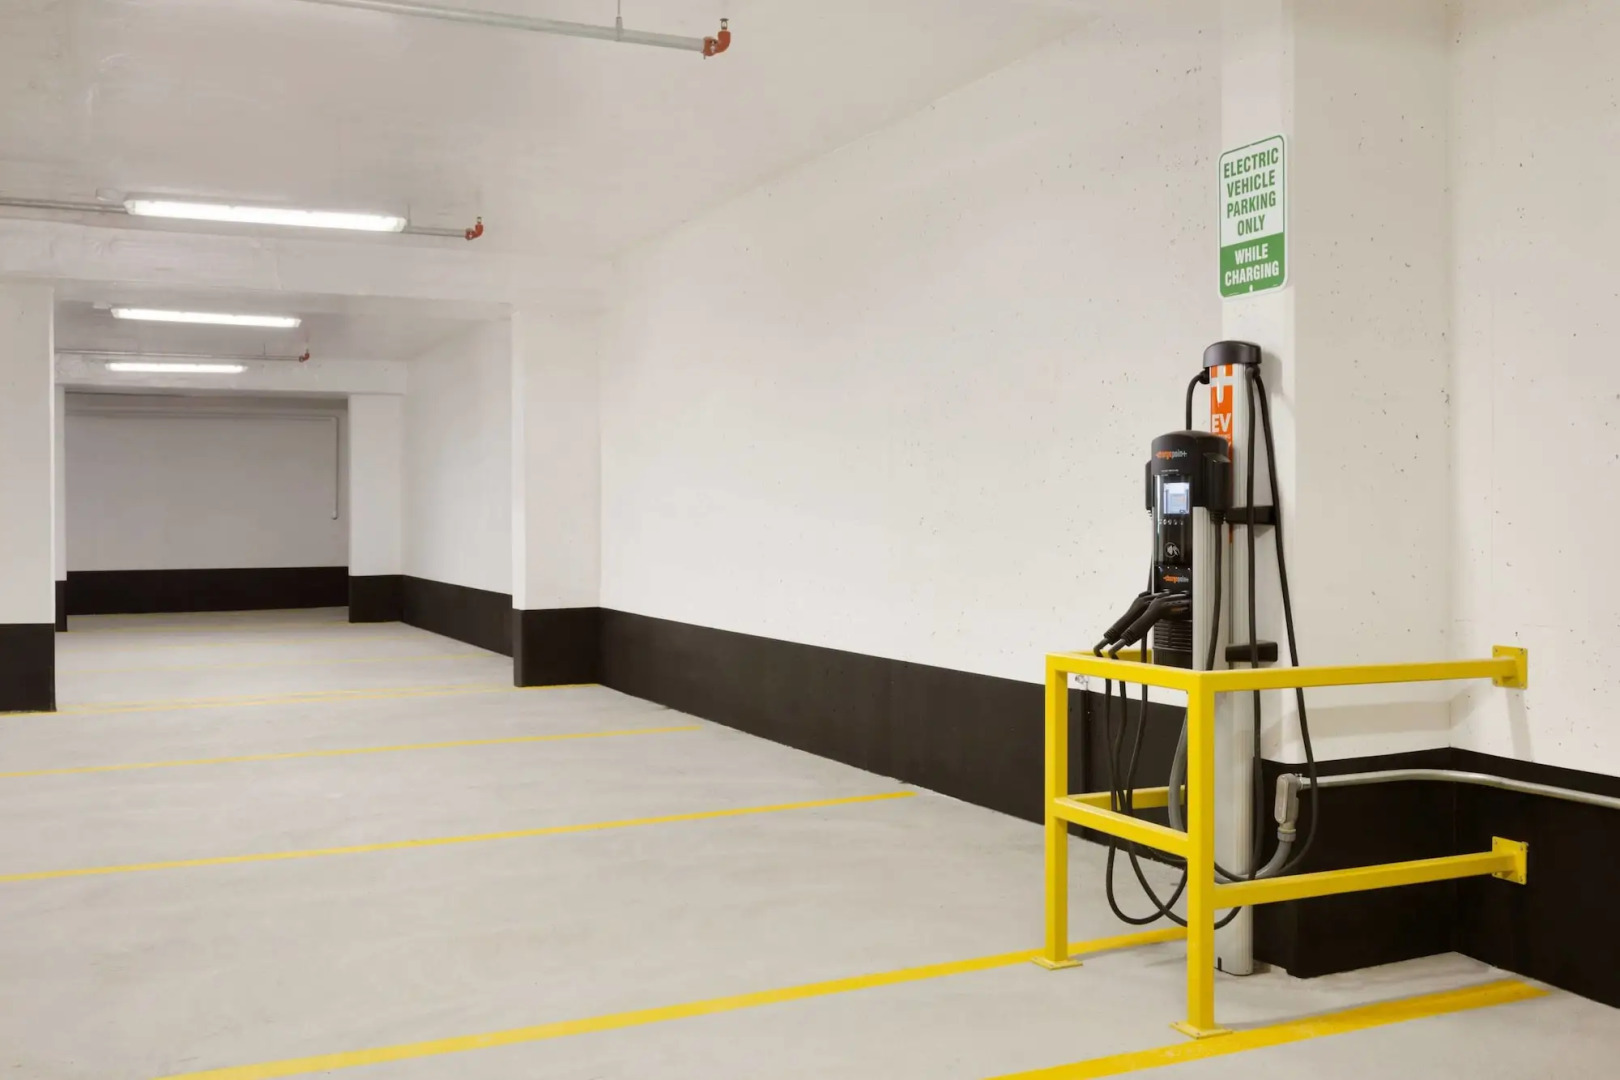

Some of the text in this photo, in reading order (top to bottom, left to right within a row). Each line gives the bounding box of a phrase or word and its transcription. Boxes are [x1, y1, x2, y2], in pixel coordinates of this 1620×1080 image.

[1223, 147, 1279, 179] ELECTRIC
[1226, 169, 1276, 198] VEHICLE
[1226, 190, 1276, 219] PARKING
[1237, 214, 1265, 236] ONLY
[1234, 243, 1269, 265] WHILE
[1224, 260, 1279, 287] CHARGING
[1211, 412, 1231, 433] EV
